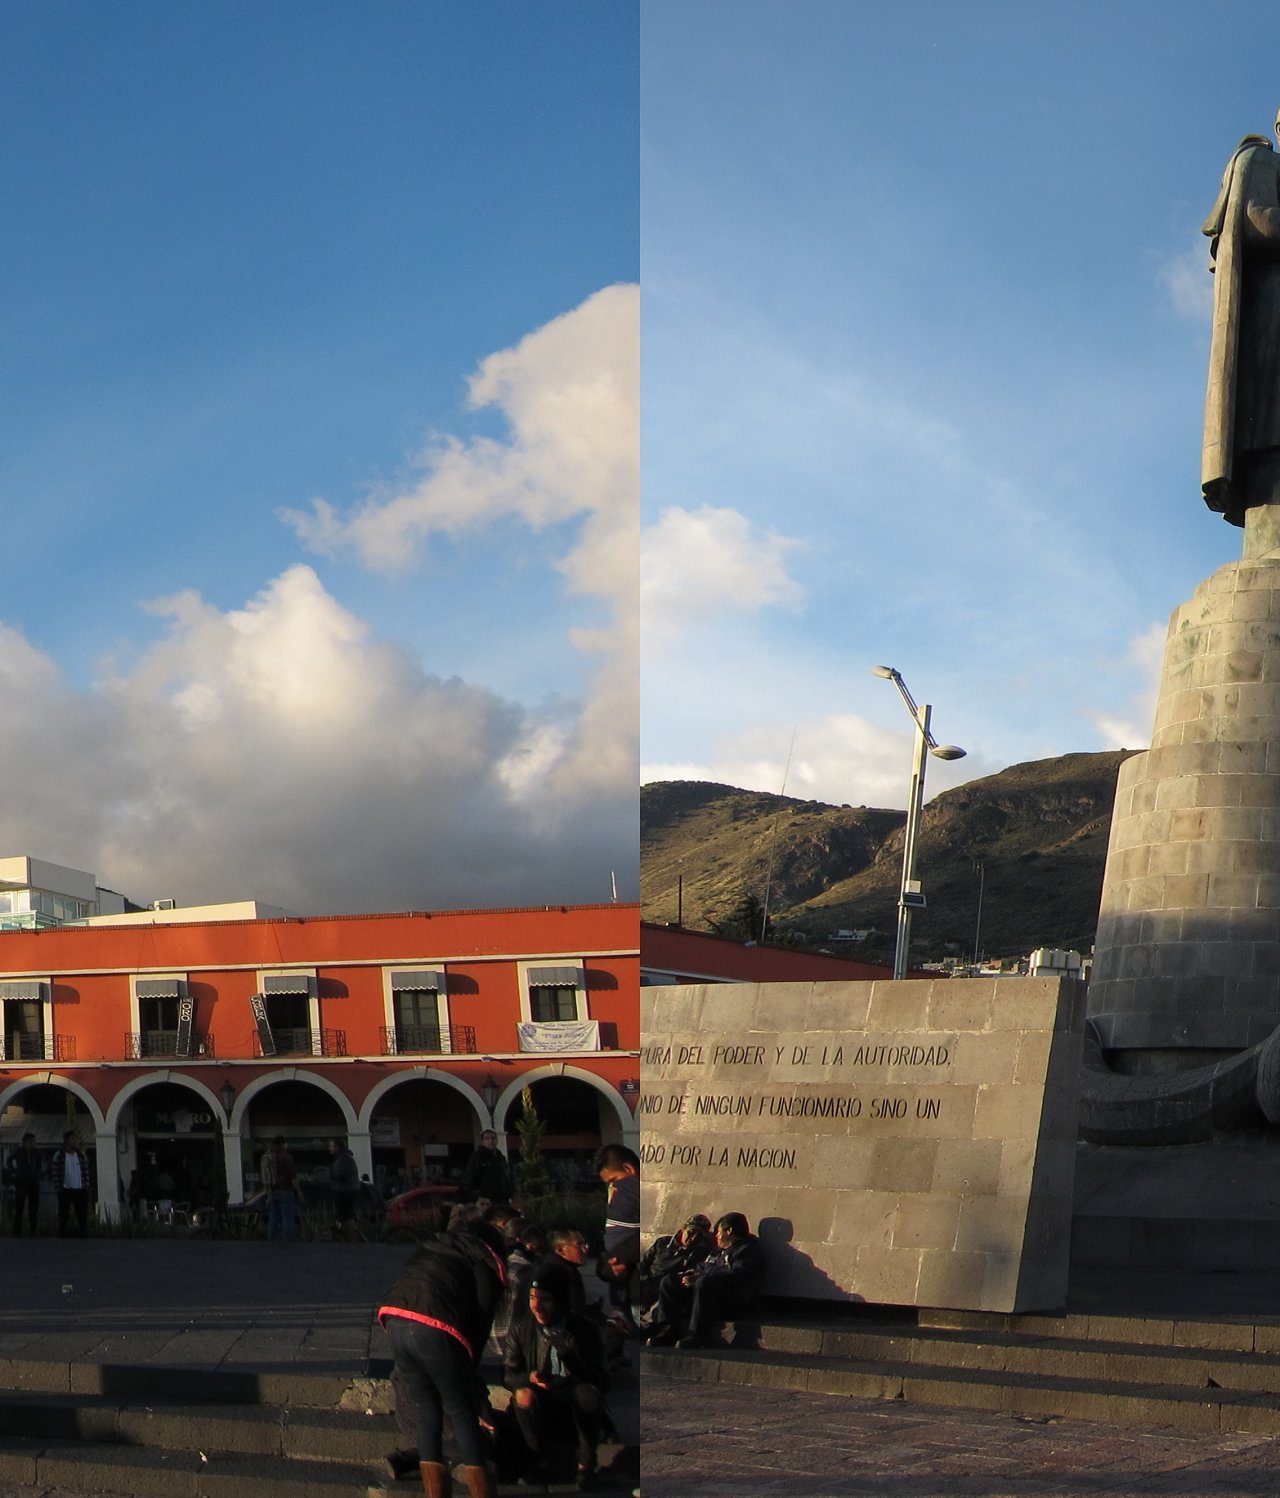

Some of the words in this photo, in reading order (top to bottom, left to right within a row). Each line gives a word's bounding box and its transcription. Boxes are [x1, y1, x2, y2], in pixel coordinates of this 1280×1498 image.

[678, 1046, 705, 1065] DEL
[713, 1046, 765, 1065] PODER
[775, 1046, 785, 1065] Y
[792, 1046, 814, 1065] DE
[821, 1046, 843, 1065] LA
[668, 1095, 689, 1115] DE
[695, 1095, 751, 1116] NINGUN
[758, 1096, 862, 1118] FUNCIONARIO
[870, 1098, 907, 1119] SINO
[916, 1098, 941, 1119] UN
[671, 1145, 701, 1166] POR
[708, 1146, 728, 1167] LA
[737, 1148, 798, 1170] NACION.
